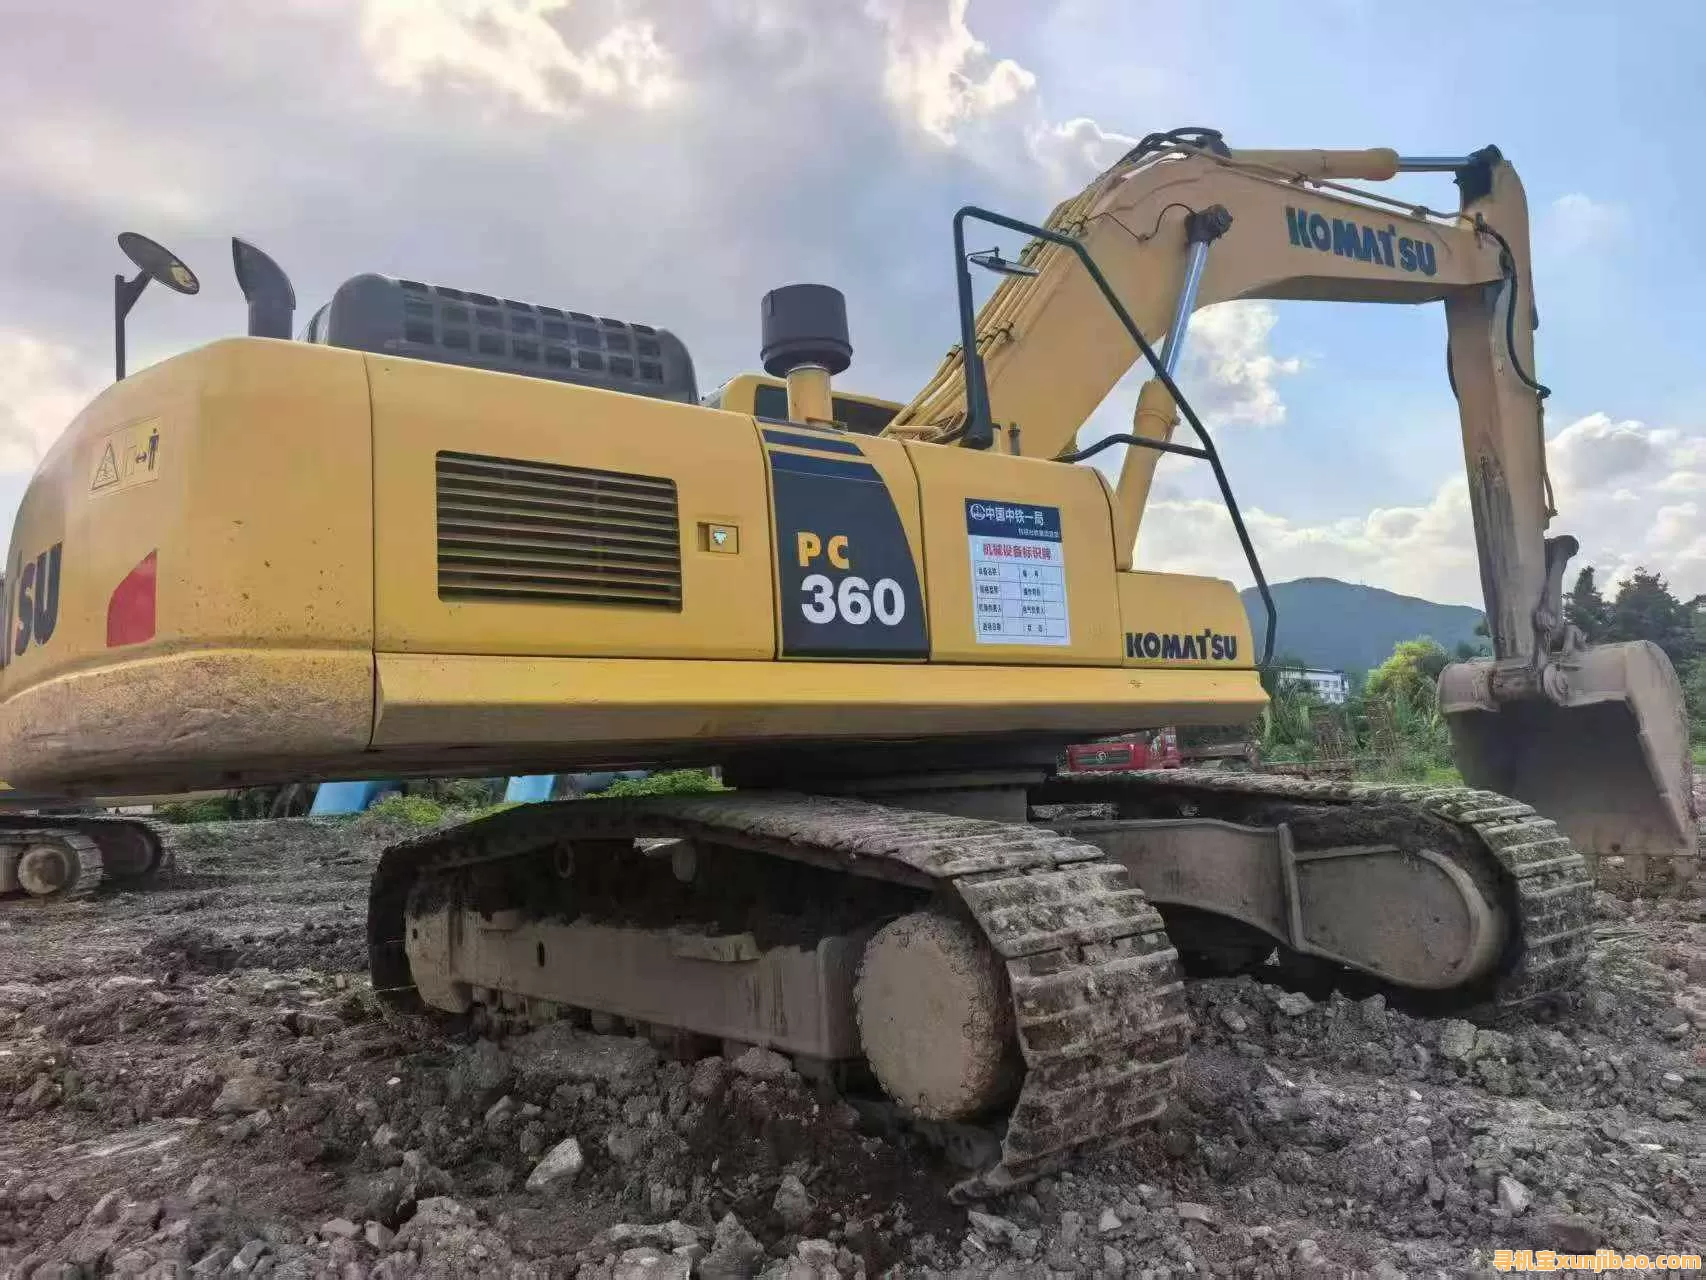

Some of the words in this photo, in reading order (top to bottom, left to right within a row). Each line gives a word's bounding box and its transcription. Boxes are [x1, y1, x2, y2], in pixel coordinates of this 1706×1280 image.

[1285, 207, 1437, 277] KOMATSU
[986, 505, 1044, 526] 中国中铁一局
[798, 531, 850, 570] PC
[983, 543, 1051, 560] 机械设备标识牌
[801, 574, 906, 626] 360
[1125, 628, 1237, 660] KOMATSU
